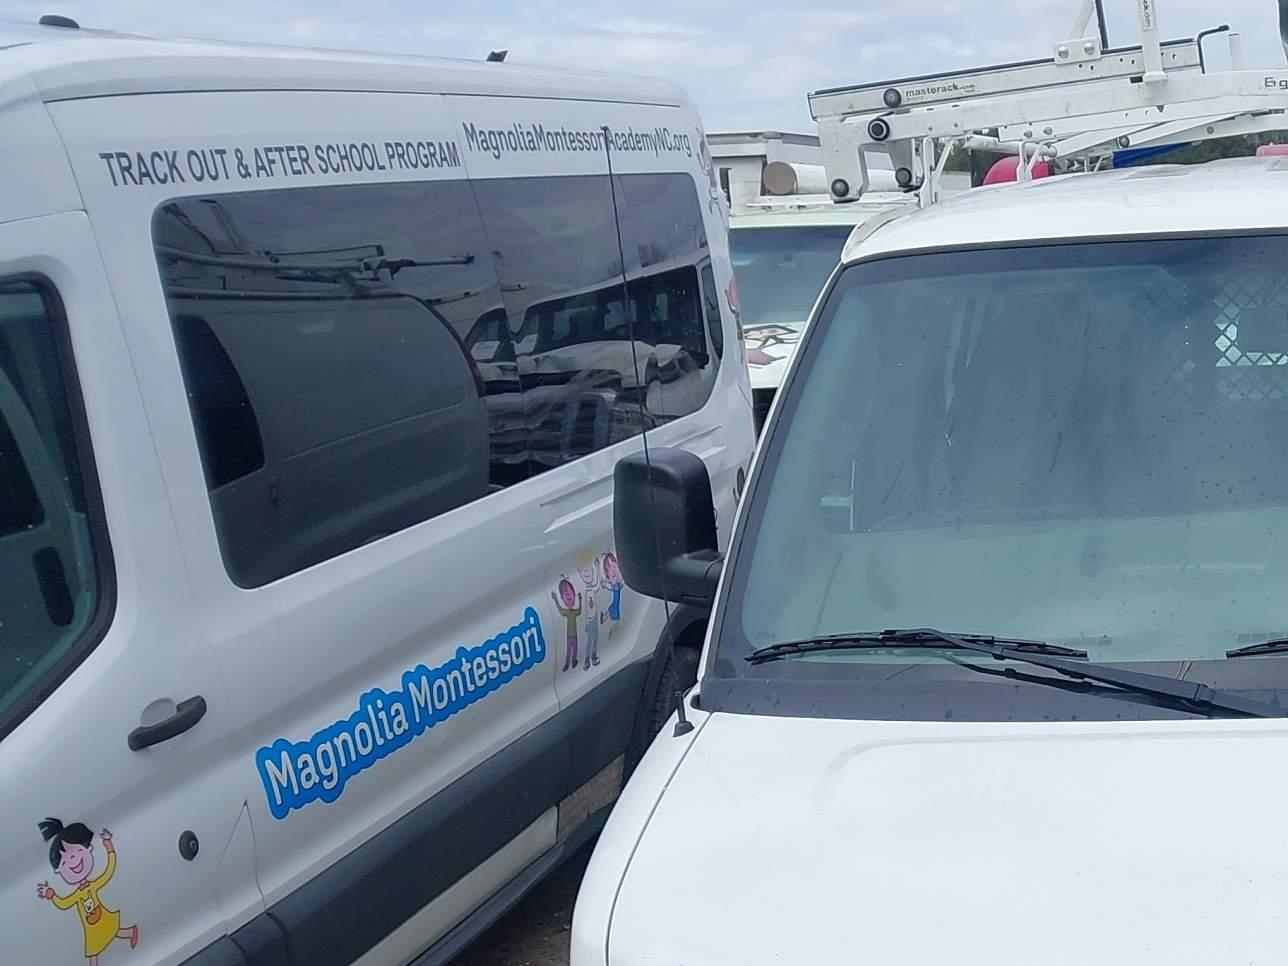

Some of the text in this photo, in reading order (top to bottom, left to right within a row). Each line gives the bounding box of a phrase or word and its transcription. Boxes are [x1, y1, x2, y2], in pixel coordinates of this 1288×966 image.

[462, 122, 692, 159] MagnoliaMontessorAcademyNC.org
[99, 141, 461, 187] TRACK OUT & AFTER SCHOOL PROGRAM
[265, 617, 542, 805] Magnolia Montessori
